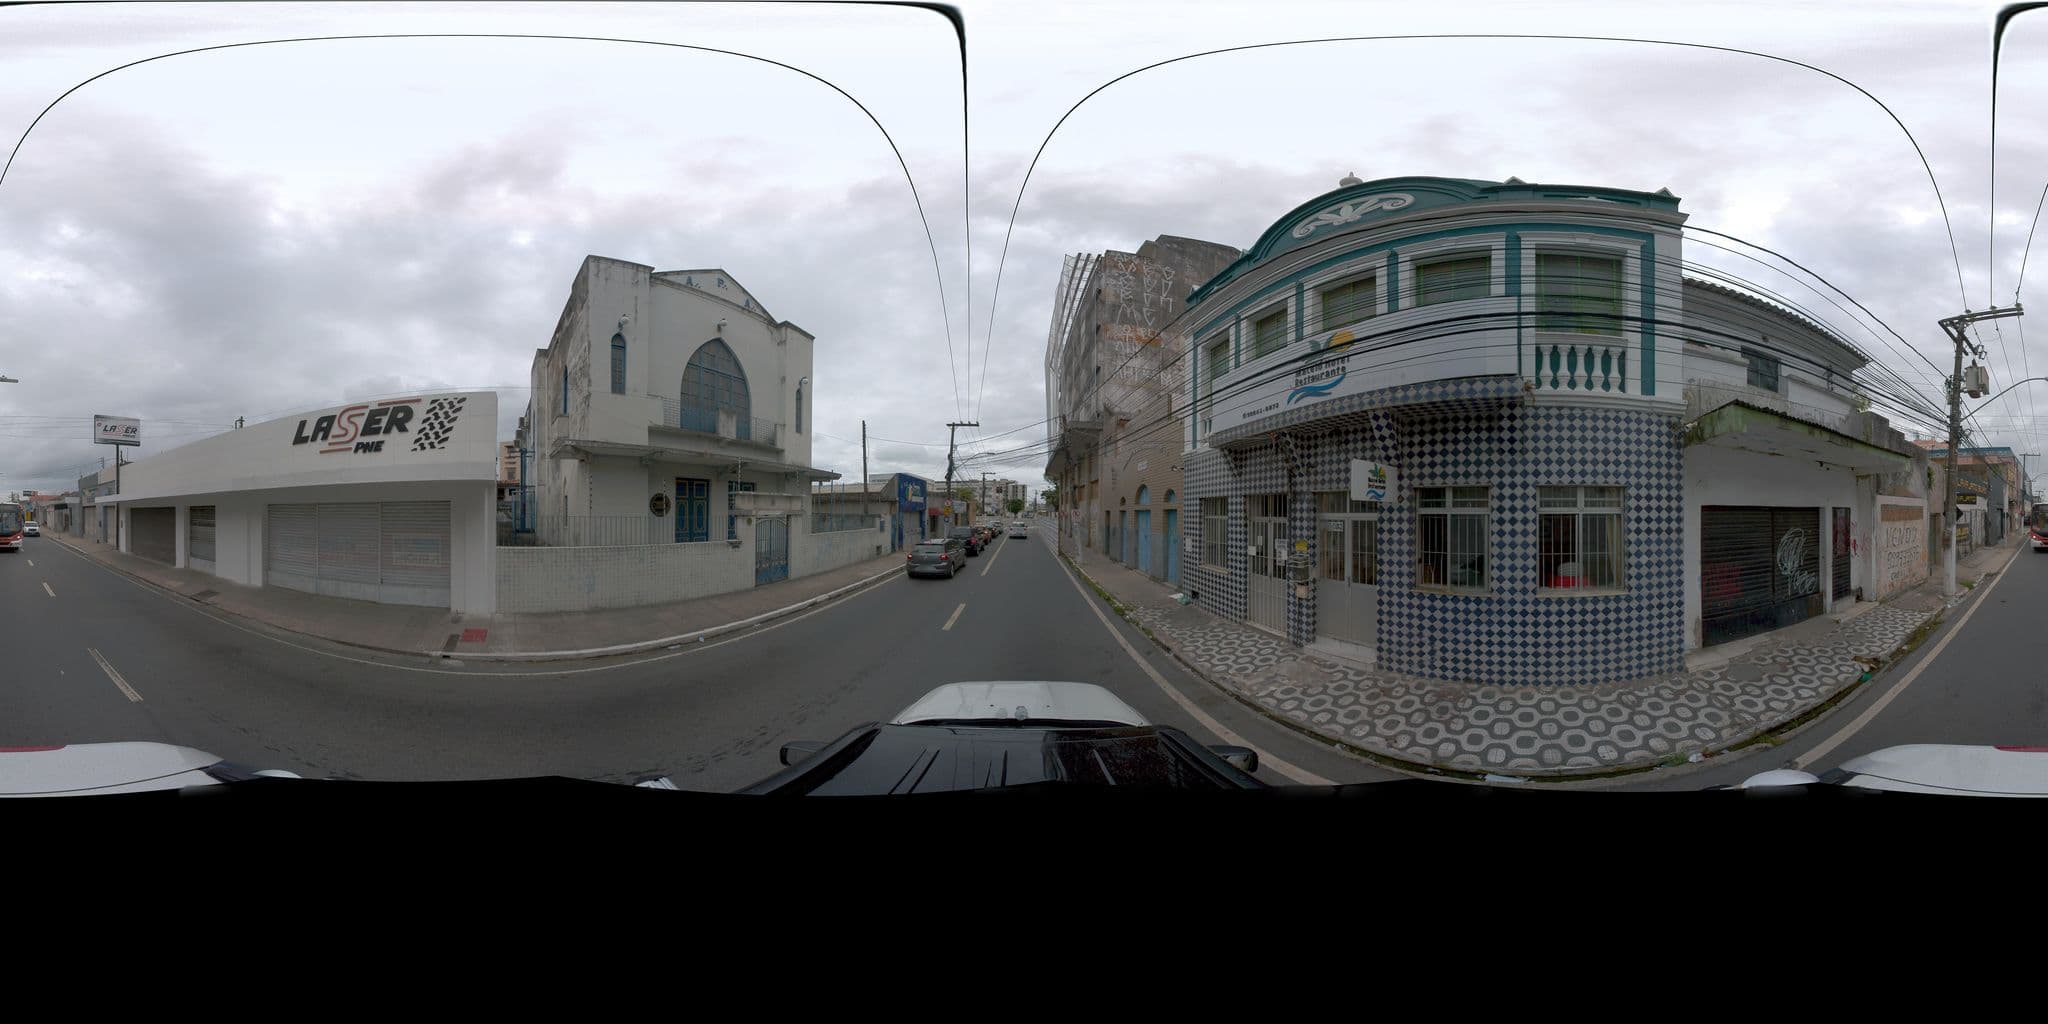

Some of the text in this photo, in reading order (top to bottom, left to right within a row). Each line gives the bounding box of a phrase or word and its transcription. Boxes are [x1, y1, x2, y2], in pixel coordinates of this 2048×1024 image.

[1295, 366, 1347, 386] Restaurante
[102, 424, 138, 435] LASER
[292, 404, 414, 446] LASER
[353, 440, 384, 454] PNE
